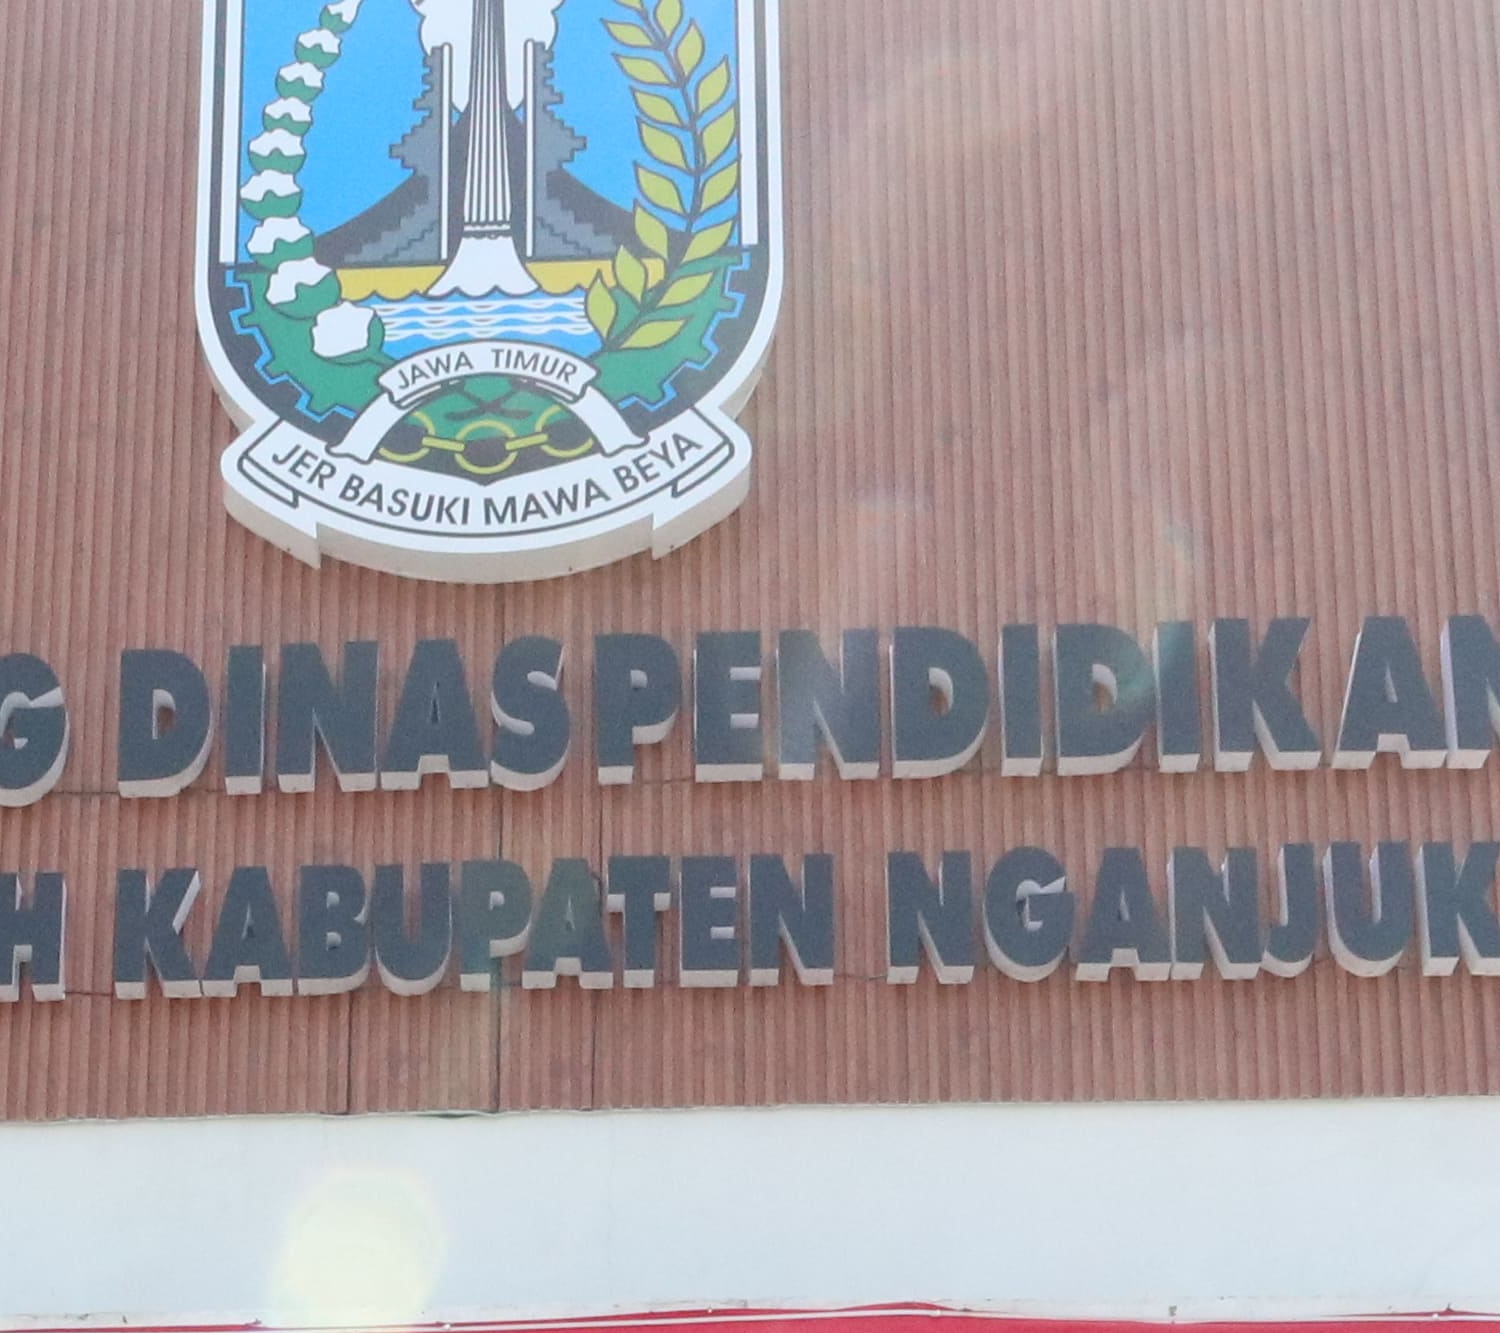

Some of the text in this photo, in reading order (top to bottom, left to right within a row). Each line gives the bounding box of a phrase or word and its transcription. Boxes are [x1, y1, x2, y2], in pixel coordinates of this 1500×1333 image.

[397, 347, 578, 391] JAWA TIMUR
[271, 431, 705, 526] JER BASUKI MAWA BEYA
[117, 636, 572, 798] DINAS
[113, 853, 835, 999] KABUPATEN
